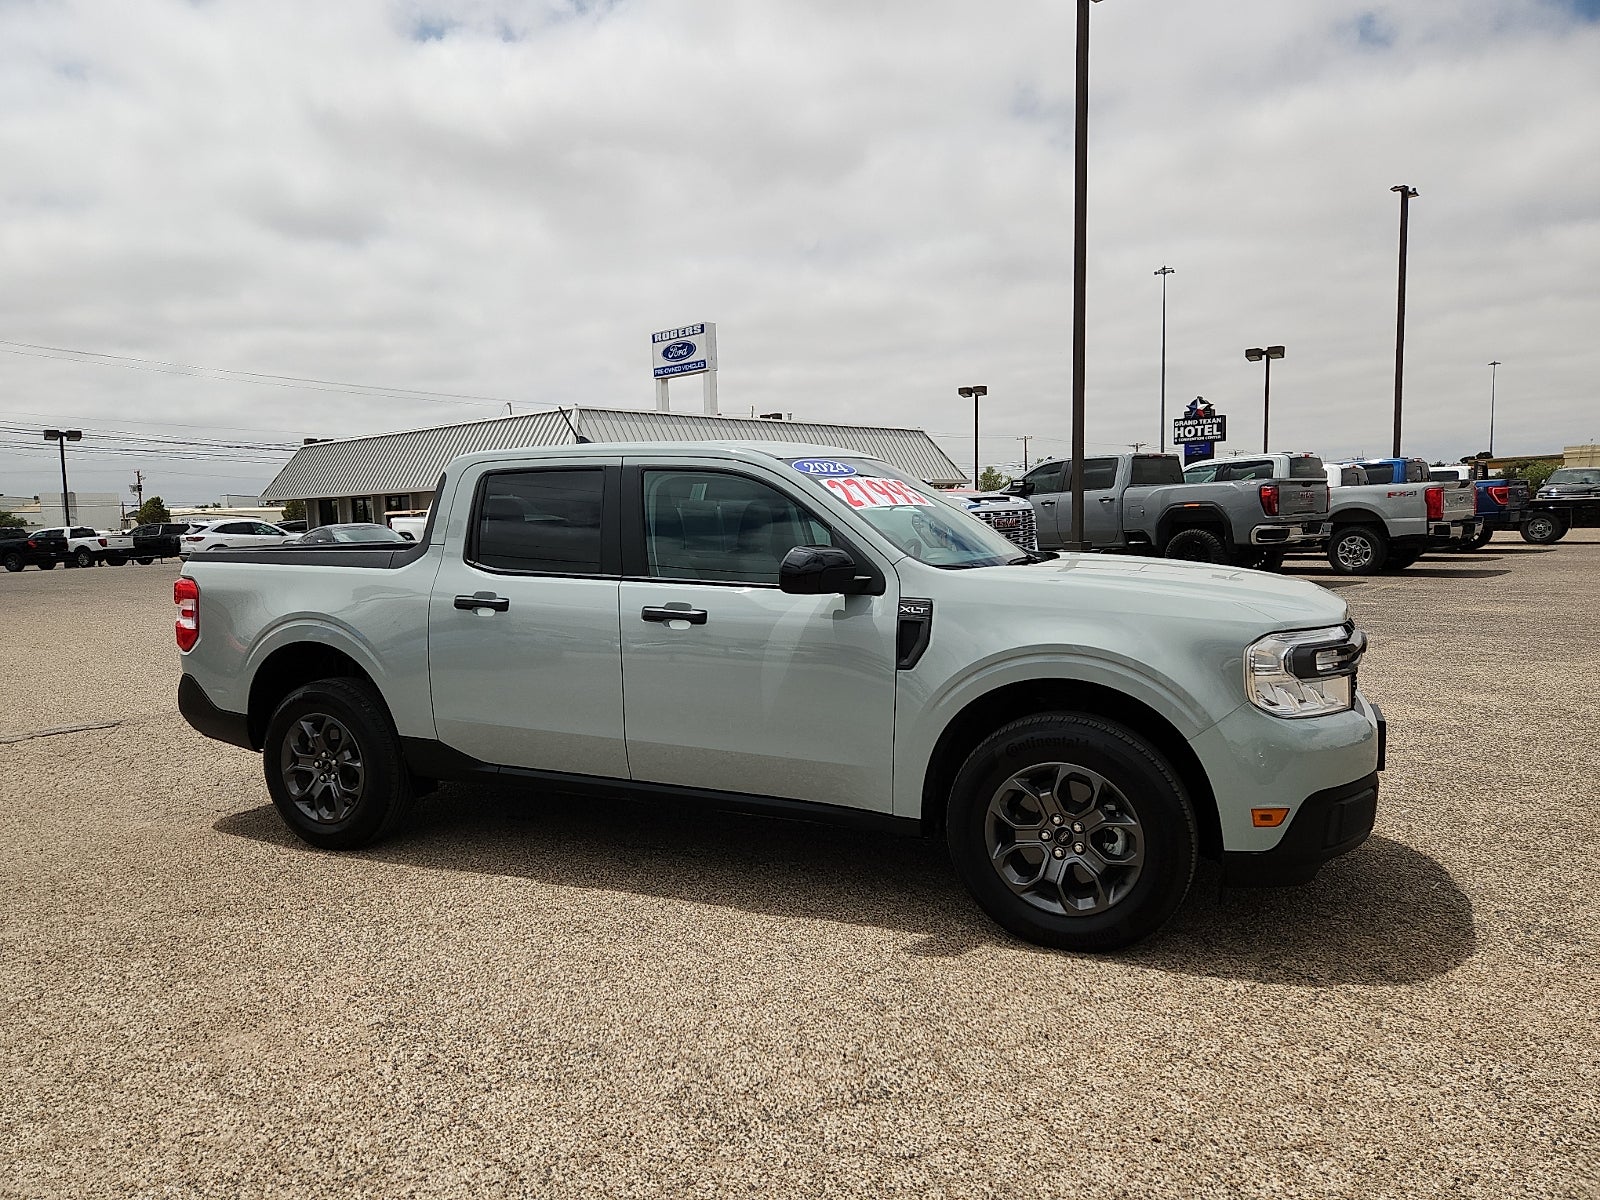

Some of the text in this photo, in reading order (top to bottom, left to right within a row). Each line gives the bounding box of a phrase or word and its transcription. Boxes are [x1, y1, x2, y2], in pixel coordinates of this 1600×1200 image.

[654, 325, 702, 343] ROGERS
[668, 344, 688, 358] Ford
[682, 361, 705, 371] VEHICLES
[1174, 417, 1222, 427] GRAND TEXAN
[1174, 423, 1221, 438] HOTEL
[804, 462, 850, 473] 2024
[826, 478, 929, 507] 27995
[900, 605, 928, 614] XLT
[1005, 737, 1081, 757] Continental
